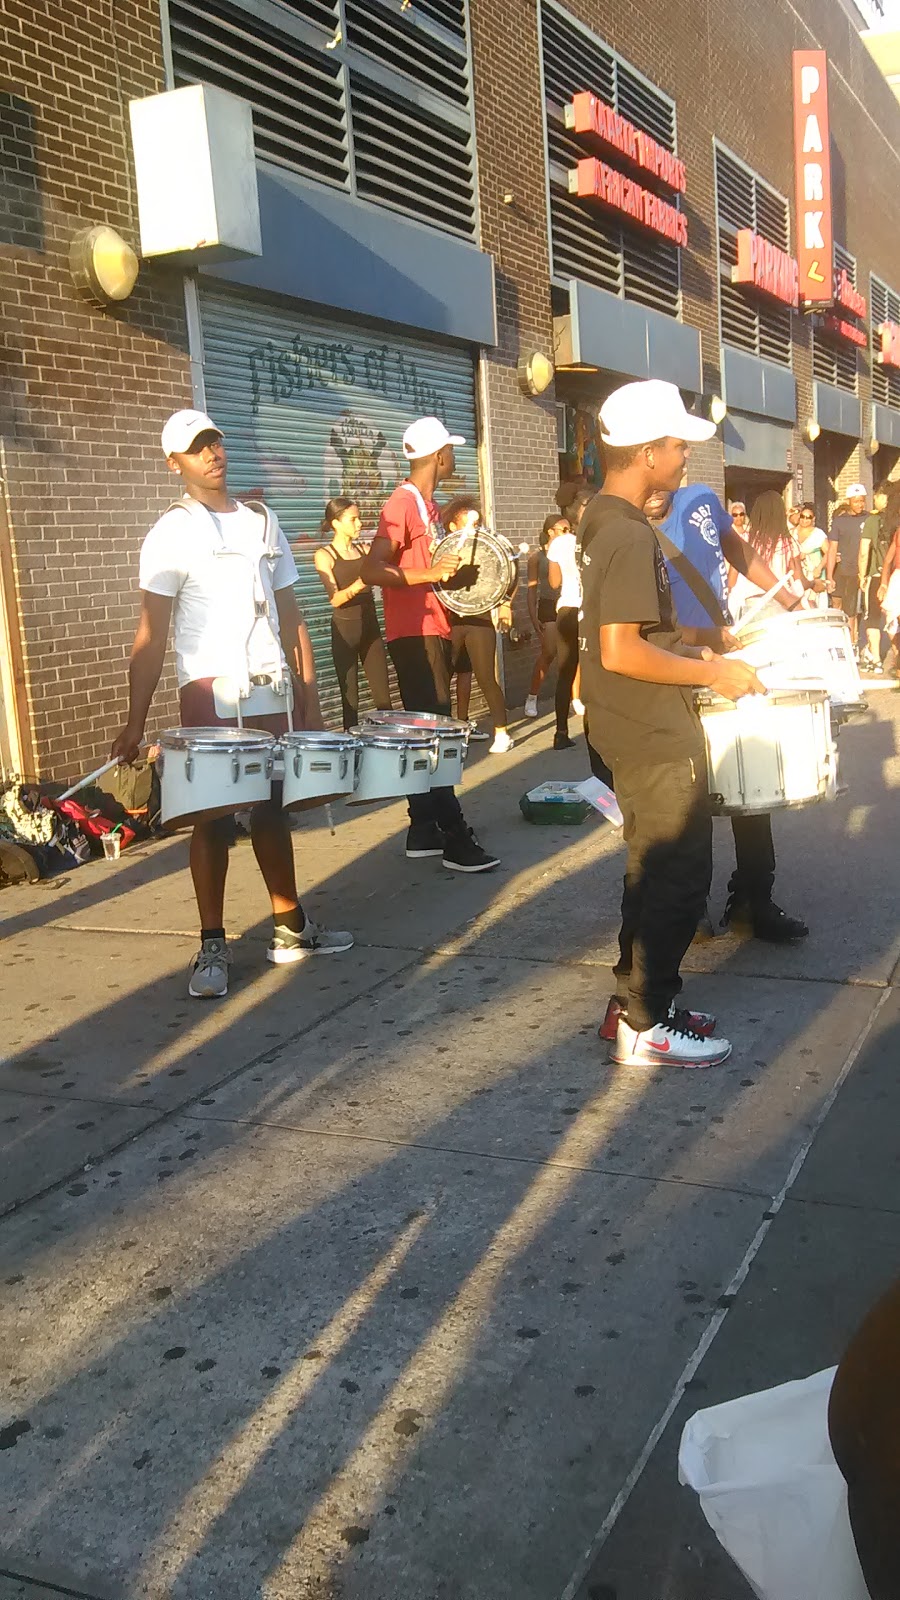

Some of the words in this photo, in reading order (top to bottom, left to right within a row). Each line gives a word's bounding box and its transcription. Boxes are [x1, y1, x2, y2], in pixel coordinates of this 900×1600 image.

[640, 130, 687, 194] IMPORTS
[801, 66, 826, 249] PARK
[594, 158, 644, 222] AFRICAN
[643, 190, 688, 248] FABRICS
[751, 233, 799, 310] PARKING
[688, 503, 712, 528] 1967
